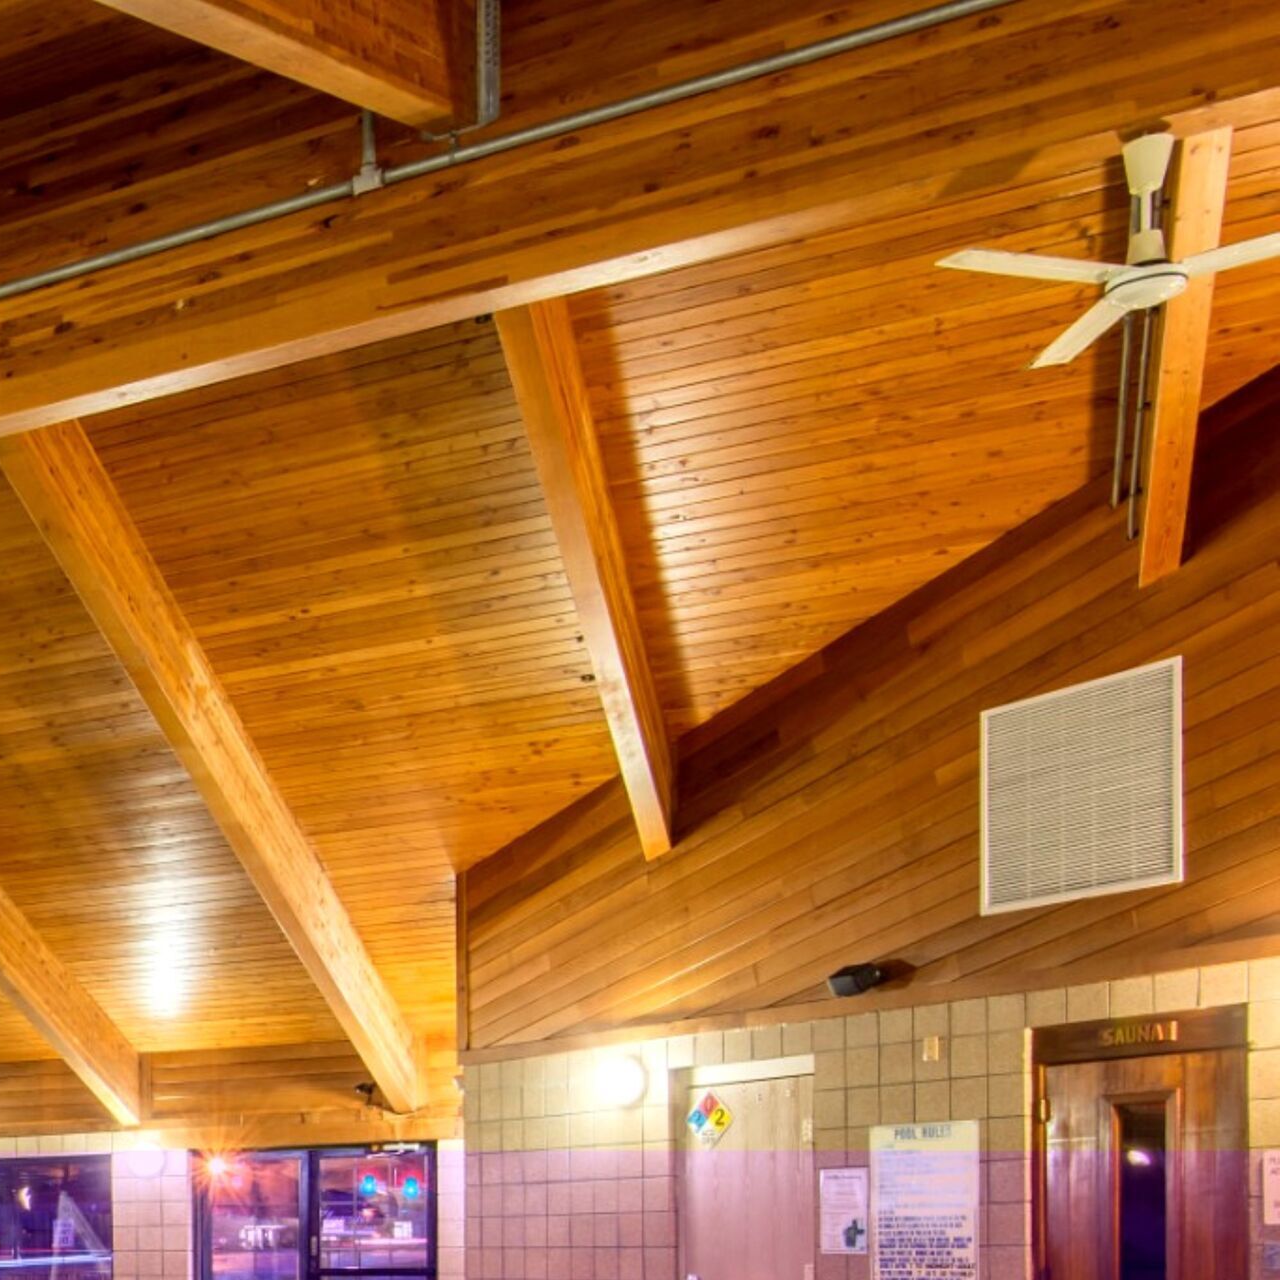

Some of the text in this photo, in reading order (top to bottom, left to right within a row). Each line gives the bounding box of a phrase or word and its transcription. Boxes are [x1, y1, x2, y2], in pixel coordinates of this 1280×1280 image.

[1100, 1023, 1164, 1046] SAUNA
[715, 1108, 725, 1126] 2
[893, 1127, 917, 1140] POOL
